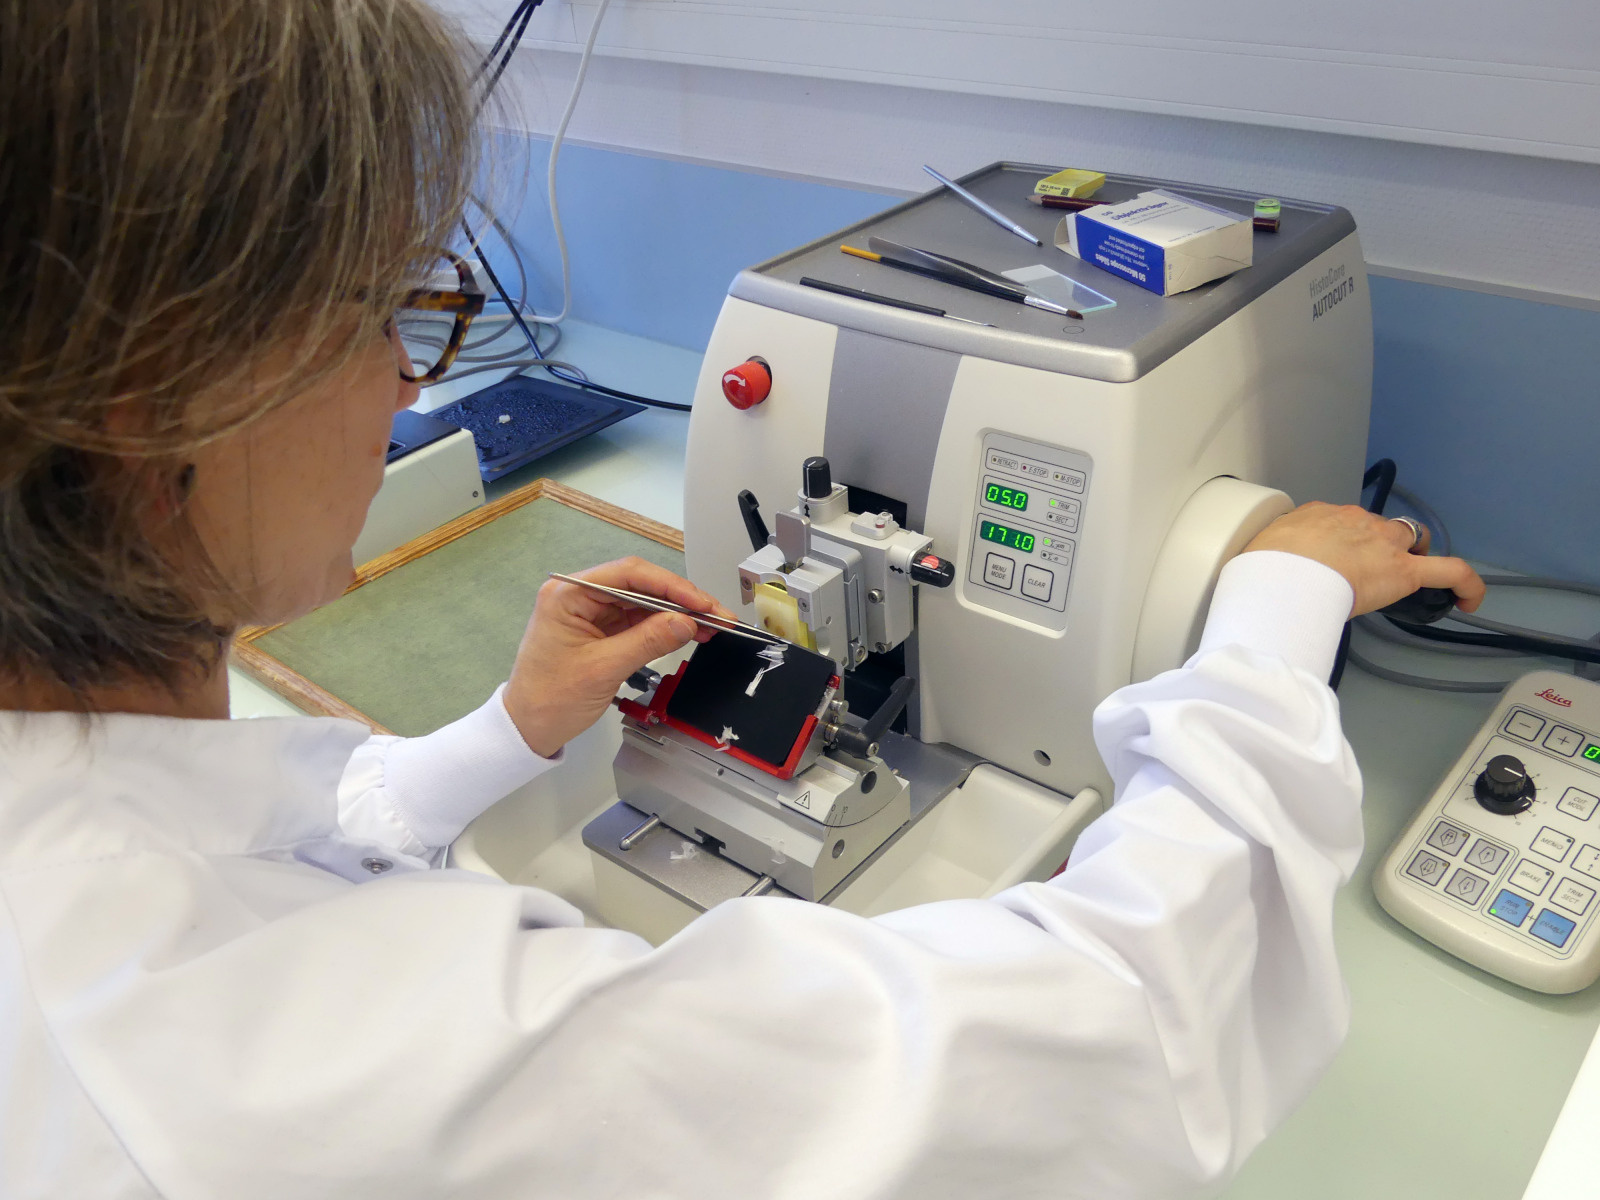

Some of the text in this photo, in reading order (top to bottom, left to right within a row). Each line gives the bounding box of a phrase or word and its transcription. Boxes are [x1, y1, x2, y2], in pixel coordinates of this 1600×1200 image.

[1095, 253, 1110, 266] Slides
[1110, 259, 1138, 279] Microscope
[1138, 272, 1146, 282] 50
[1309, 264, 1346, 299] HistoCore
[1312, 276, 1354, 322] AUTOCUT R
[997, 458, 1016, 469] RETRACT
[1028, 466, 1047, 477] E-STOP
[1061, 475, 1081, 487] M-STOP
[986, 486, 1027, 509] 05.0
[1057, 501, 1071, 510] TRIM
[1055, 515, 1069, 524] SECT
[987, 526, 1035, 552] 171.0
[992, 563, 1008, 573] MENU
[991, 570, 1007, 580] MODE
[1027, 578, 1046, 588] CLEAR
[1534, 688, 1573, 708] Leica
[1573, 796, 1588, 805] CUT
[1519, 870, 1542, 883] BRAKE
[1569, 887, 1584, 898] TRIM
[1505, 899, 1521, 909] RUN
[1561, 894, 1580, 904] SECT
[1500, 906, 1518, 916] STOP
[1539, 920, 1566, 936] ENABLE
